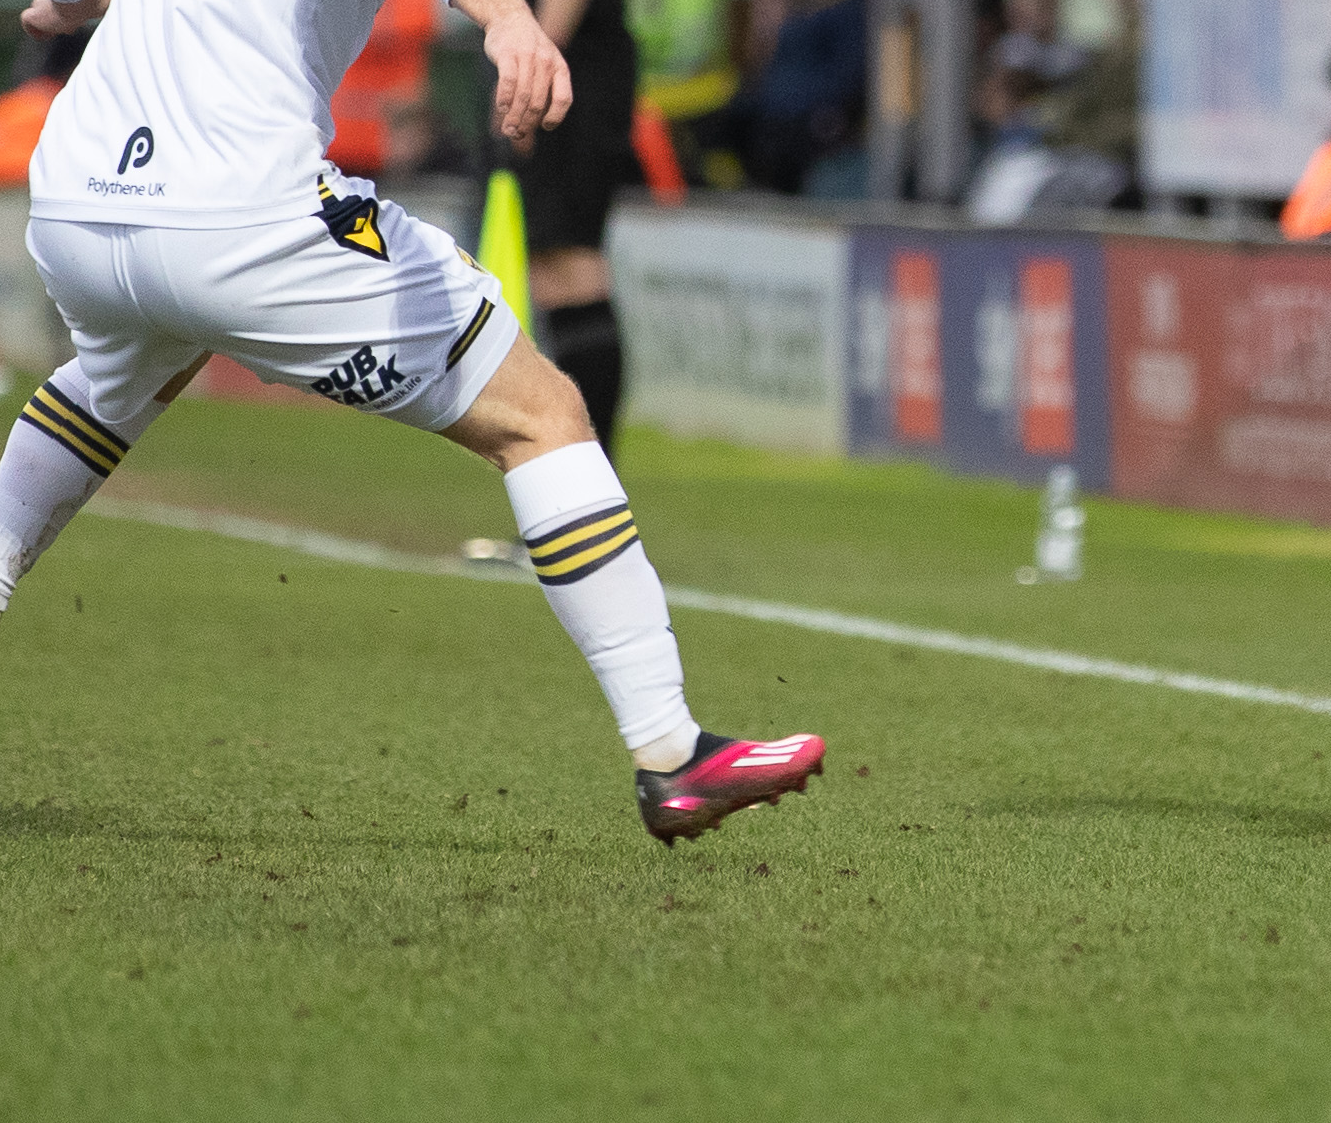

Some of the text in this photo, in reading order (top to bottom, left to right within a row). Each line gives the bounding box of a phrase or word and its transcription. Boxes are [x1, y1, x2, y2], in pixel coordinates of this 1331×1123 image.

[87, 177, 167, 197] Polythene UK
[310, 345, 377, 395] PUB
